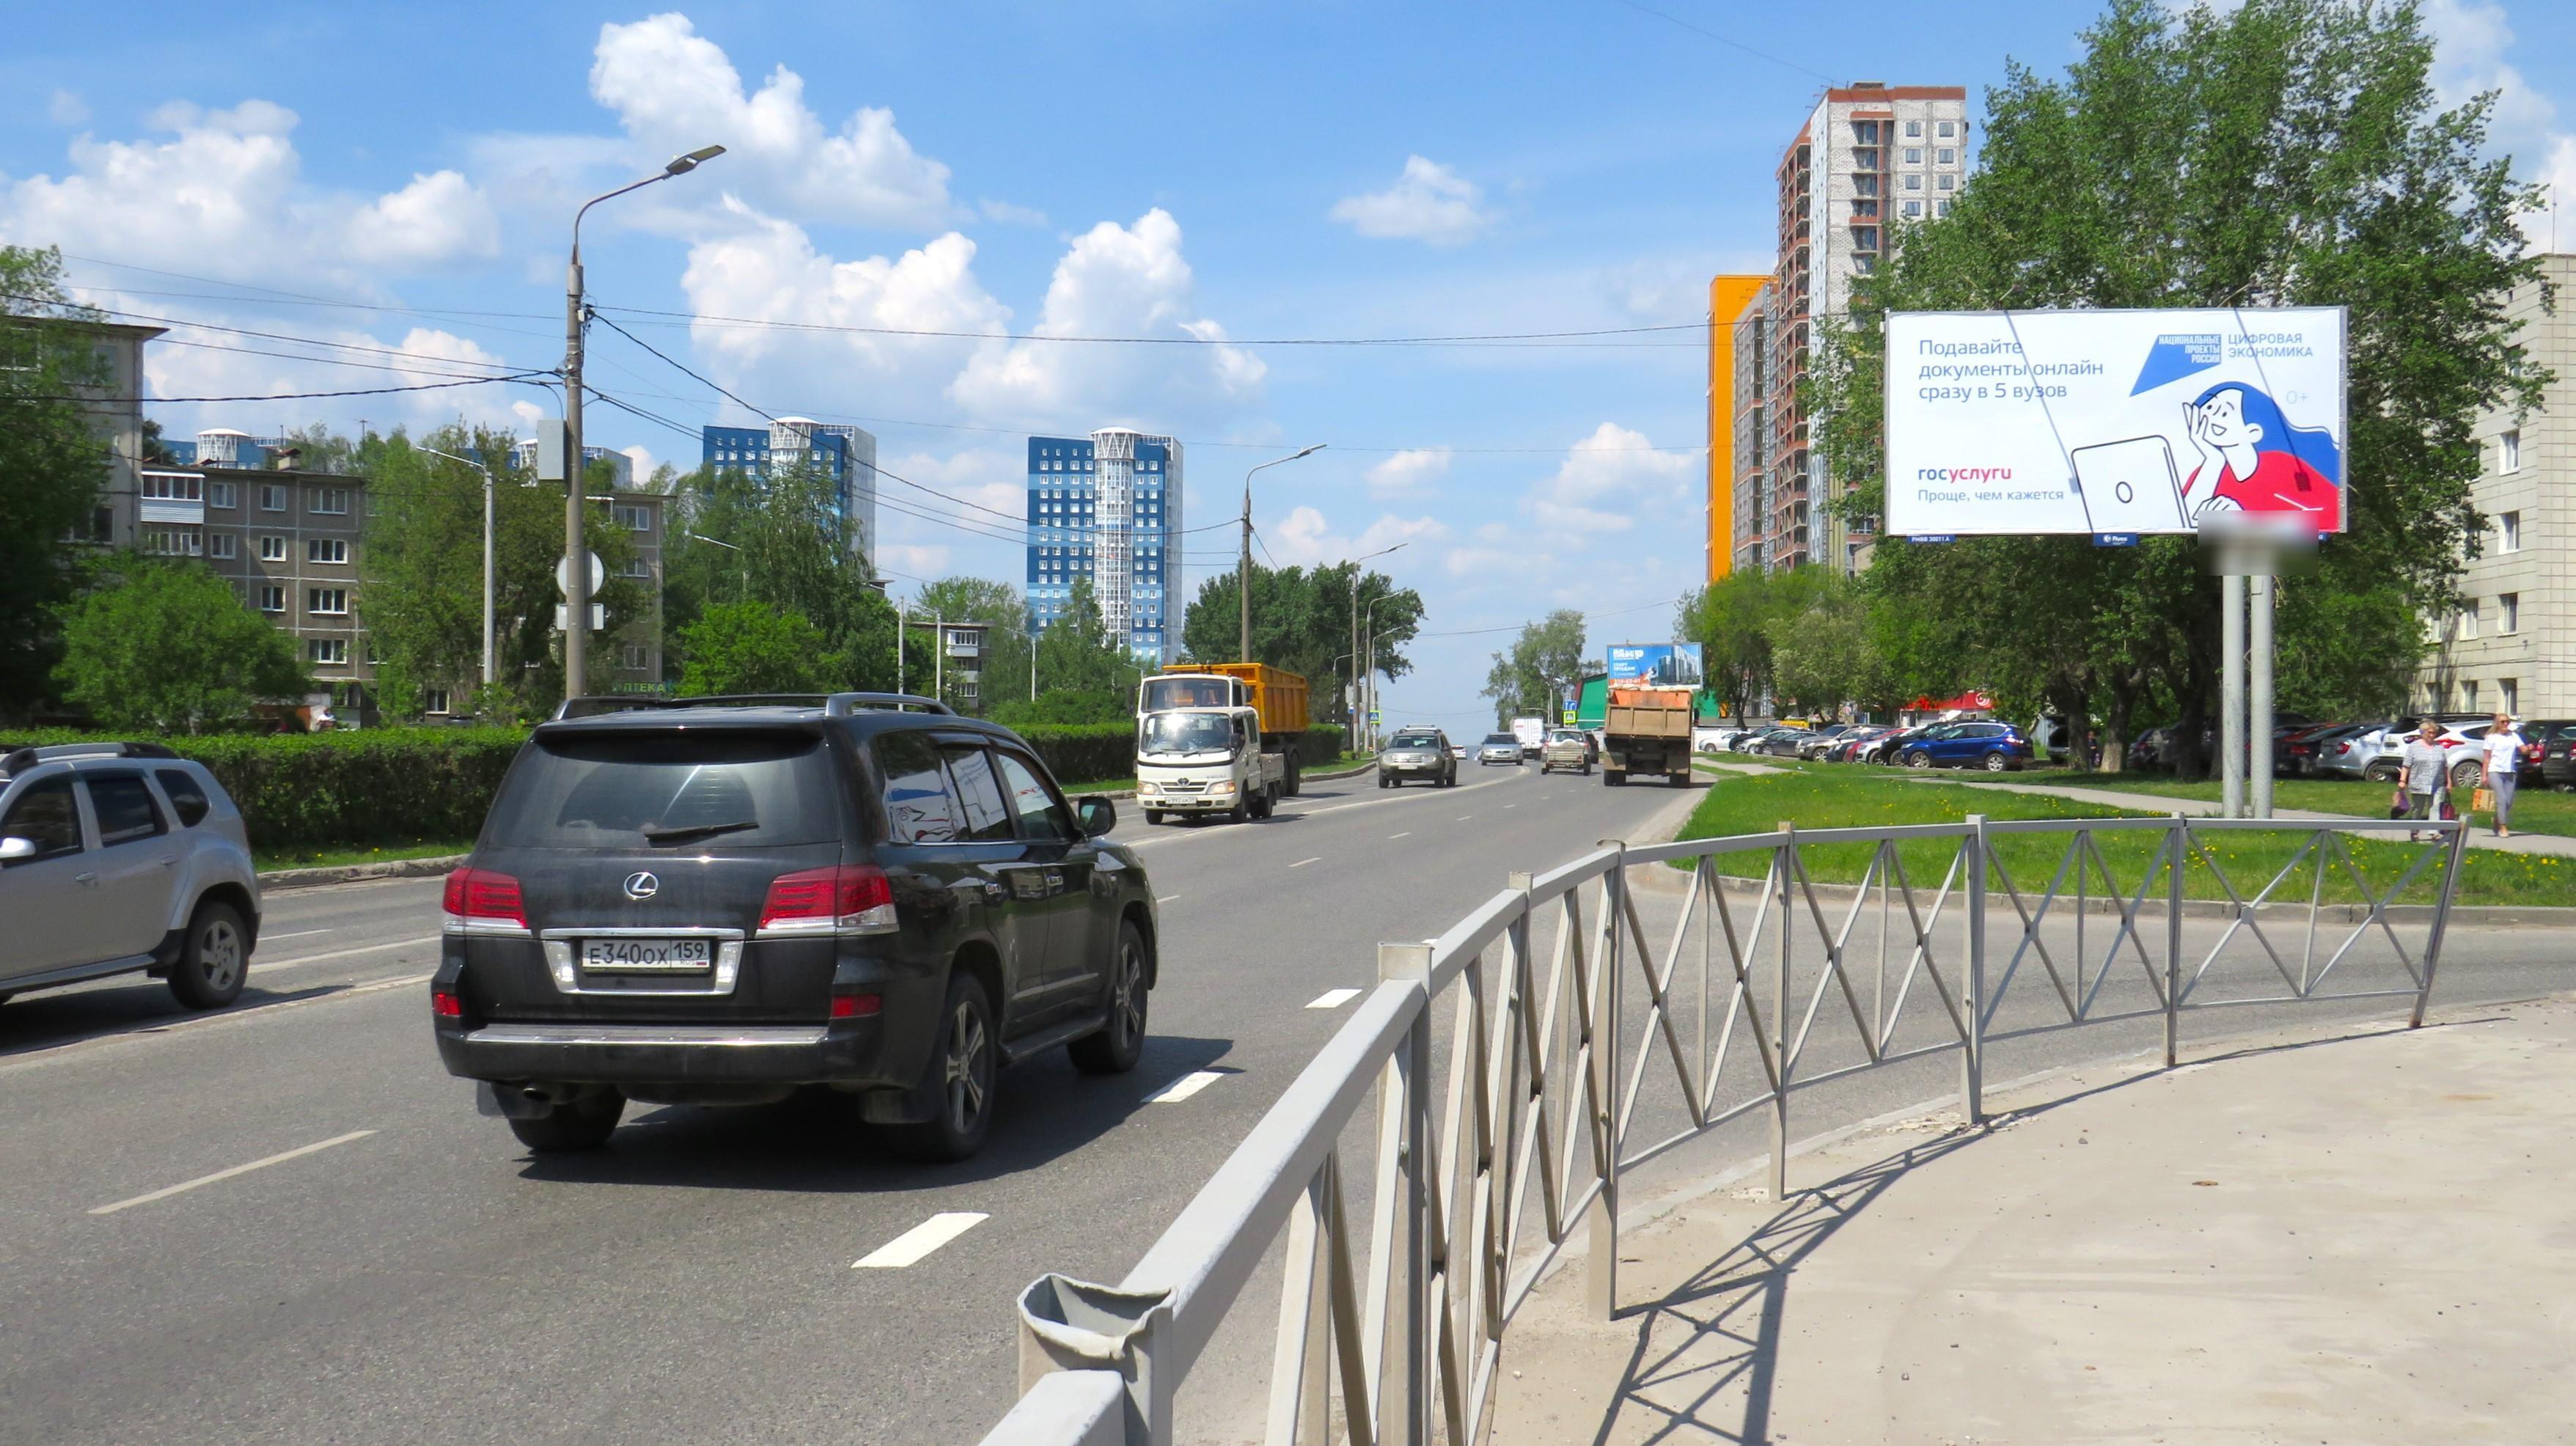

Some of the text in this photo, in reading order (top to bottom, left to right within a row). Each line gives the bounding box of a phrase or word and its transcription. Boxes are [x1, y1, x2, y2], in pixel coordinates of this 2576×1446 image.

[2158, 335, 2220, 345] НАЦИОНАЛЬНЫЕ
[2228, 333, 2302, 345] ЦИФРОВАЯ
[1919, 339, 2022, 358] Подавайте
[2184, 345, 2220, 354] ПРОЕКТЫ
[2228, 347, 2313, 358] ЭКОНОМИКА
[2191, 354, 2220, 364] РОССИИ
[1918, 359, 2103, 381] документы онлайн
[1919, 383, 2068, 403] сразу в 5 вузов
[2286, 390, 2308, 405] 0+
[1918, 468, 2012, 484] госуслуги
[1918, 489, 2064, 504] Проще, чем кажется
[613, 683, 665, 693] ПТЕКА
[673, 942, 705, 959] 159
